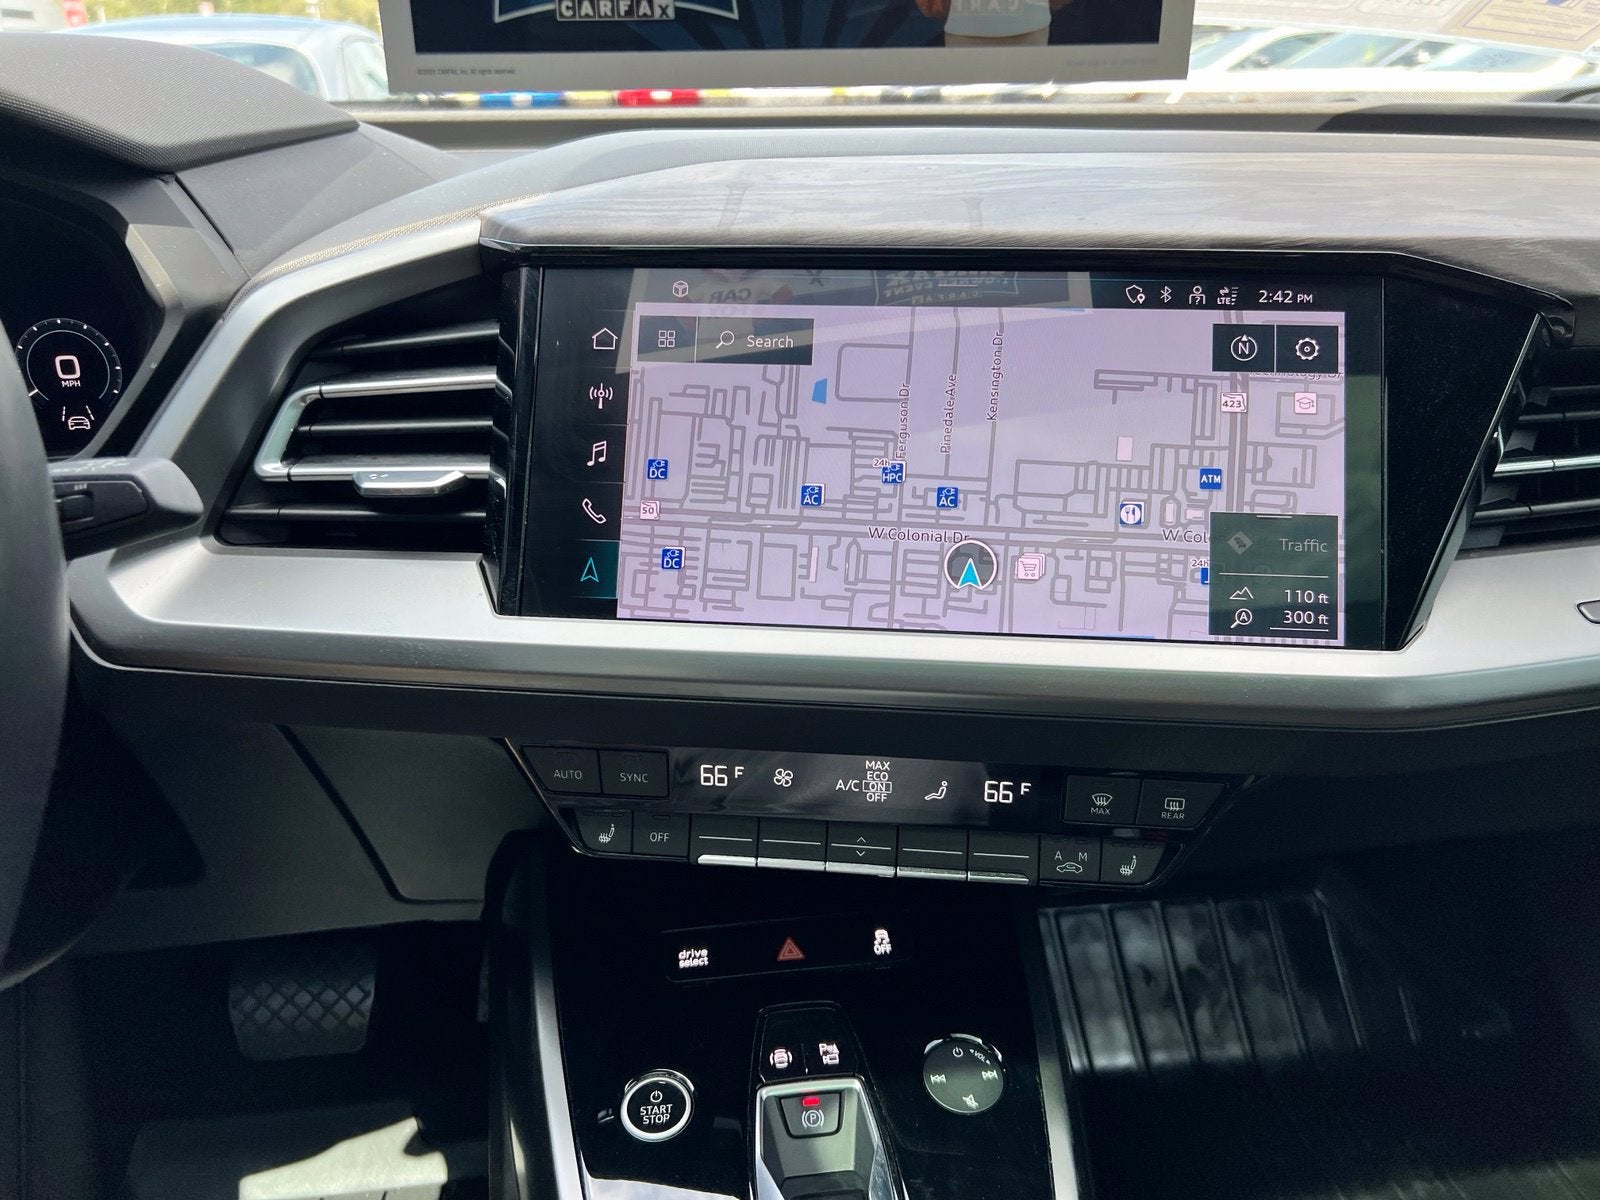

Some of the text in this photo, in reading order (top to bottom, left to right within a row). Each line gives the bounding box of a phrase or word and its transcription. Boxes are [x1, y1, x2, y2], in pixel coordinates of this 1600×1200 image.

[560, 0, 673, 19] CARFAX
[1217, 297, 1232, 305] LTE
[1258, 289, 1313, 303] 2:42 PM
[746, 334, 794, 349] Search
[55, 355, 81, 379] 0
[986, 331, 1004, 422] Kensington Dr
[61, 379, 81, 388] MPH
[1222, 399, 1242, 409] 423
[940, 374, 957, 454] Pinedale Ave
[895, 382, 911, 459] Ferguson Dr
[649, 468, 666, 479] DC
[882, 472, 902, 482] HPC
[1200, 474, 1221, 484] ATM
[803, 495, 819, 505] AC
[938, 496, 955, 507] AC
[642, 506, 655, 515] 50
[868, 527, 885, 539] W
[888, 528, 948, 543] Colonial
[1162, 529, 1179, 541] W
[1279, 538, 1328, 553] Traffic
[663, 558, 680, 569] DC
[1285, 589, 1329, 604] 110 ft
[1283, 610, 1329, 625] 300 ft
[865, 760, 891, 771] MAX
[553, 769, 583, 780] AUTO
[619, 772, 649, 783] SYNC
[700, 764, 745, 787] 66 F
[866, 771, 889, 781] ECO
[835, 779, 886, 792] A/C ON
[866, 792, 888, 802] OFF
[984, 780, 1032, 803] 66 F
[1090, 807, 1111, 815] MAX
[1161, 811, 1185, 820] REAR
[649, 832, 670, 842] OFF
[1054, 850, 1088, 862] A M
[678, 949, 708, 960] drive
[873, 944, 892, 955] OFF
[679, 956, 709, 968] select
[974, 1050, 986, 1062] VOL
[640, 1103, 673, 1116] START
[643, 1113, 670, 1125] STOP
